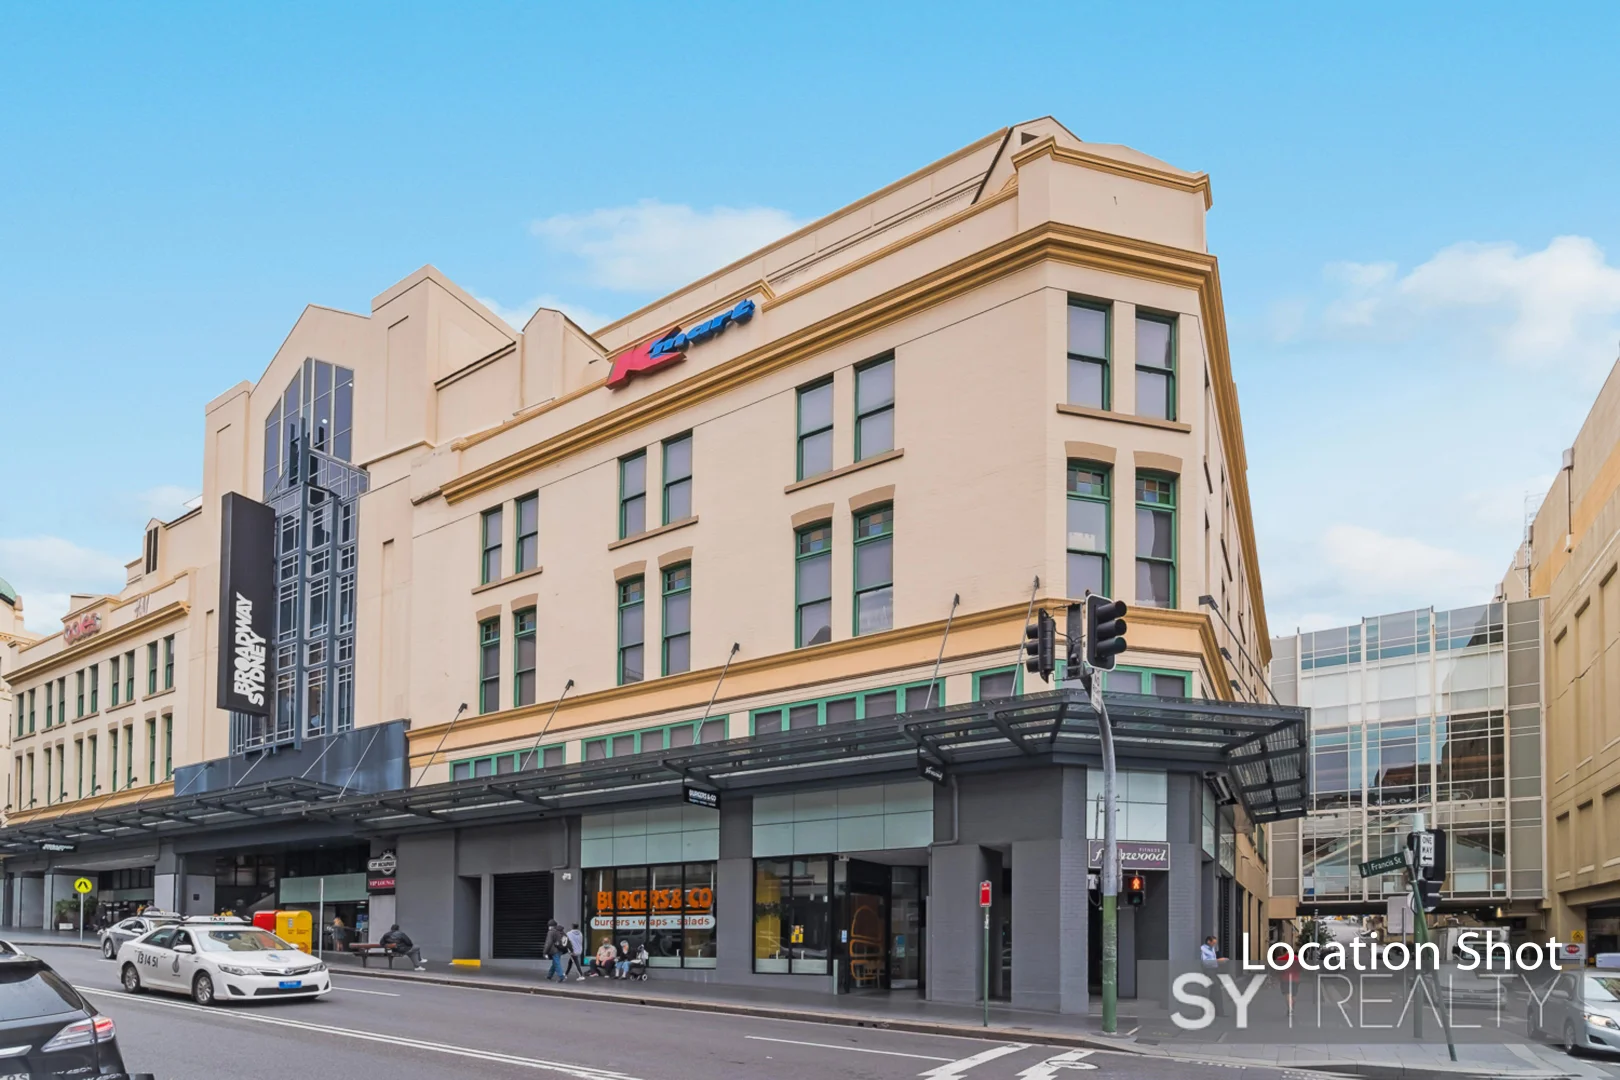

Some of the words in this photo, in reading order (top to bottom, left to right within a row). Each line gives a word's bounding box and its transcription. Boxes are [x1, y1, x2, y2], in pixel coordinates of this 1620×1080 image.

[605, 298, 756, 391] Kmart
[233, 591, 253, 696] BROADWAY
[247, 630, 266, 707] SYDNEY
[1422, 836, 1433, 845] ONE
[1091, 848, 1167, 862] fnwood
[1422, 846, 1433, 854] WAY
[1370, 860, 1394, 871] Francis
[1393, 856, 1402, 865] St
[688, 887, 713, 909] CO
[638, 919, 667, 928] waps
